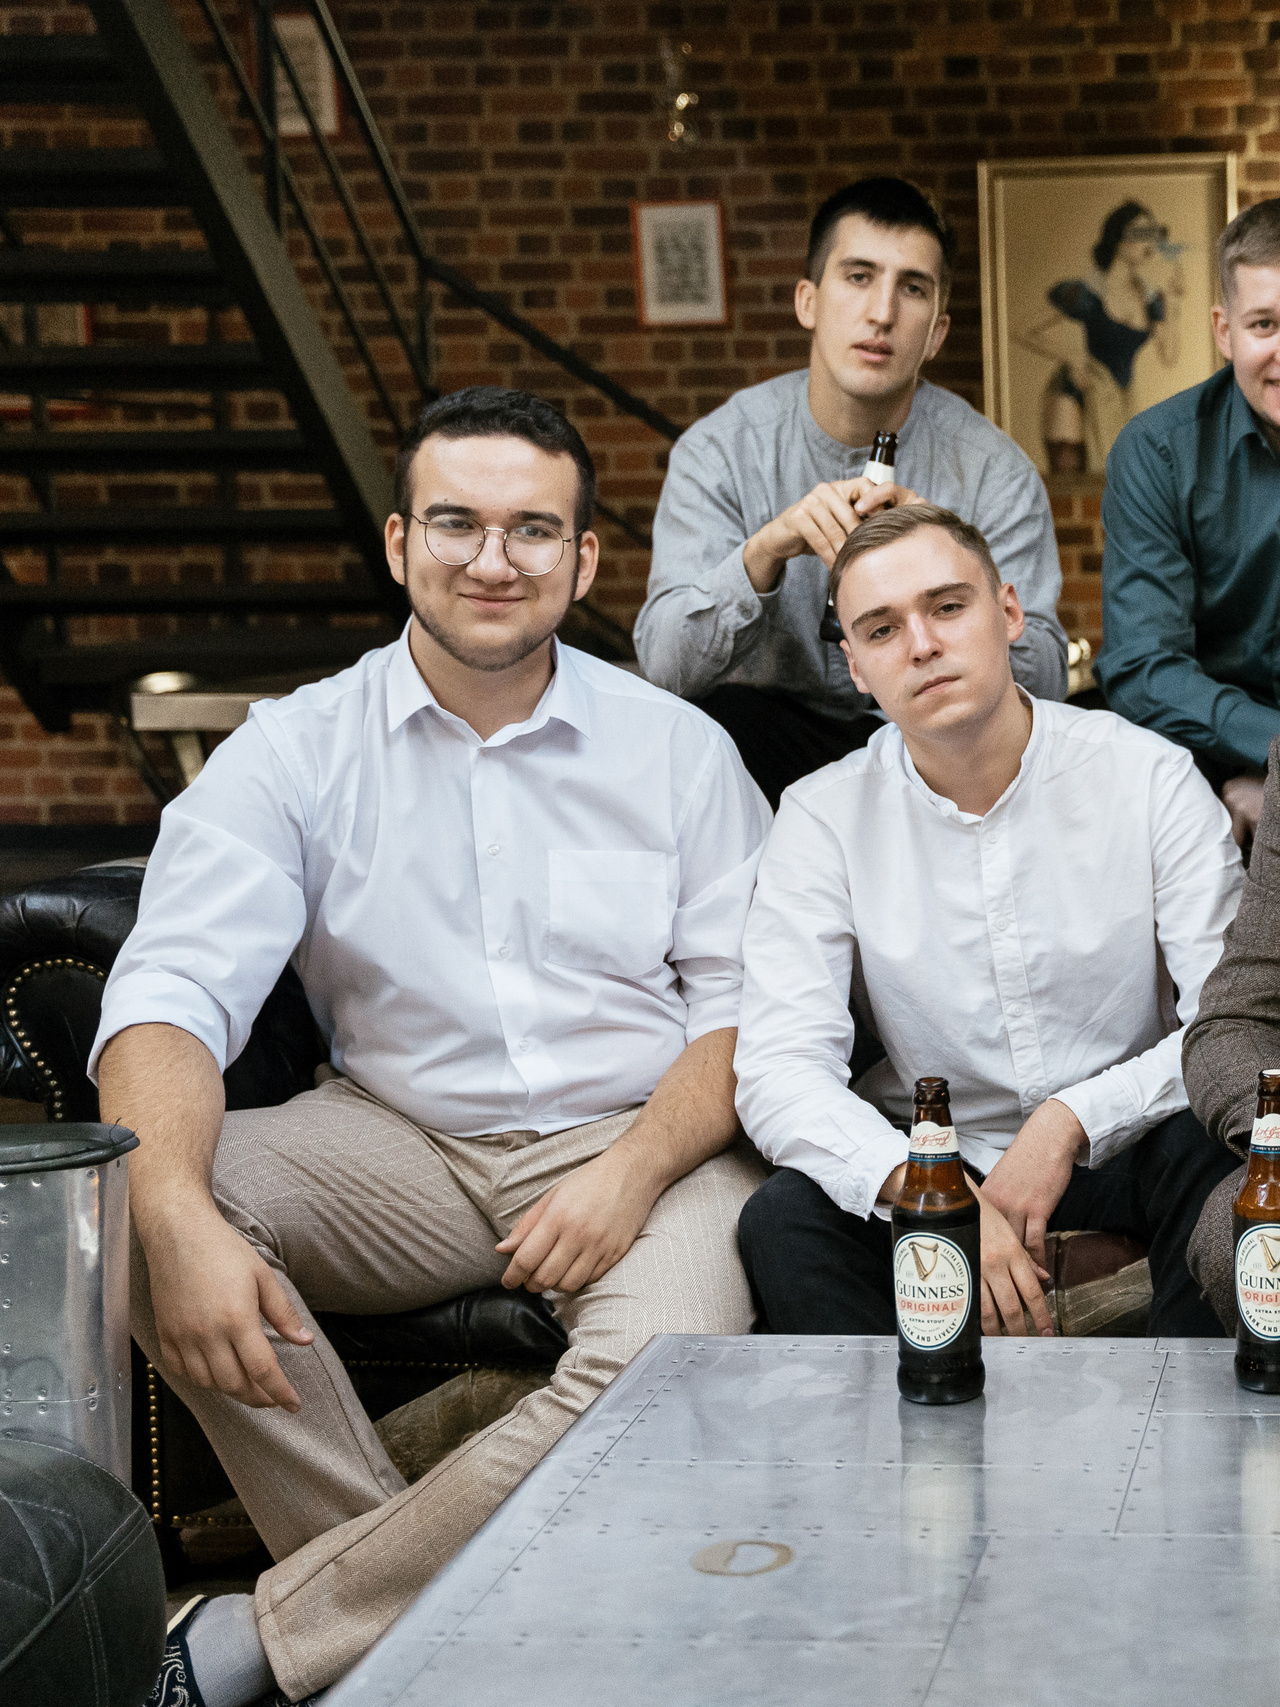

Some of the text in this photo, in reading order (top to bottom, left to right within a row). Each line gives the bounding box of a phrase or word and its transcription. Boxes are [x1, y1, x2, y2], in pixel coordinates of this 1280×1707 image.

[943, 1248, 957, 1262] EXTRA
[896, 1279, 964, 1299] GUINNESS
[901, 1300, 957, 1312] ORIGINAL
[916, 1334, 931, 1342] AND
